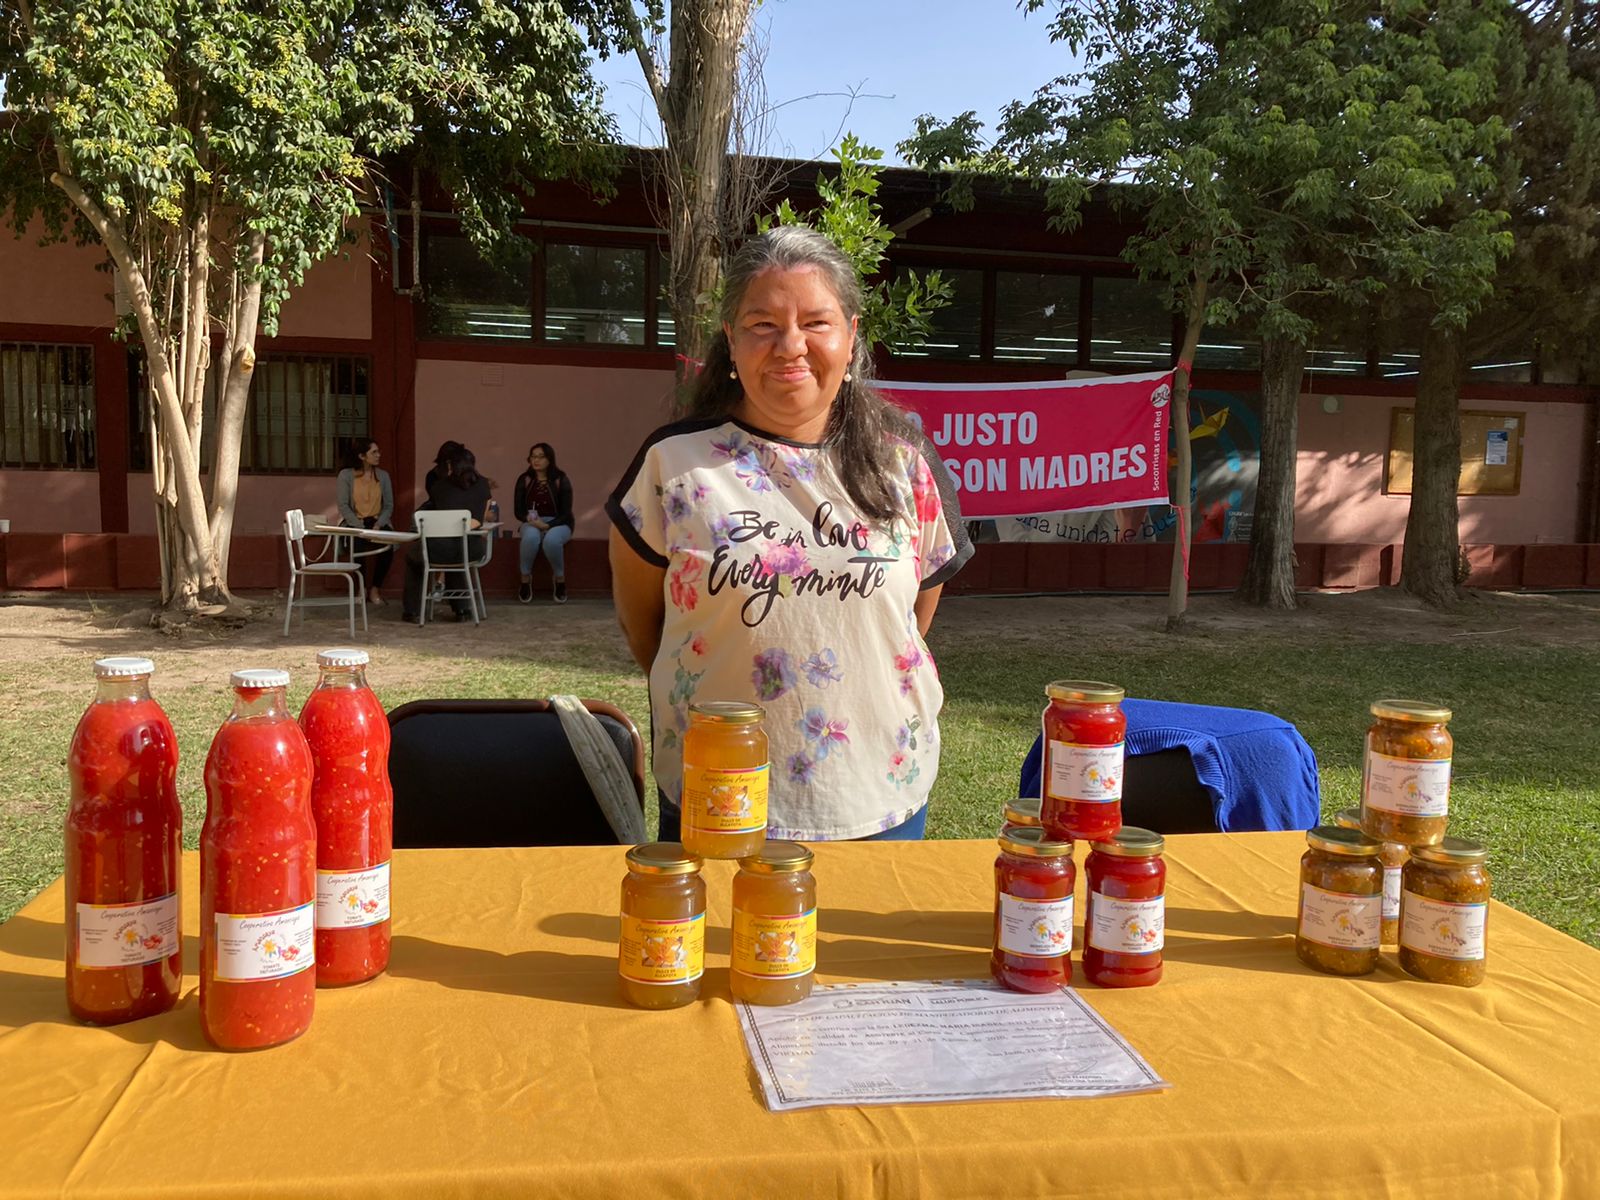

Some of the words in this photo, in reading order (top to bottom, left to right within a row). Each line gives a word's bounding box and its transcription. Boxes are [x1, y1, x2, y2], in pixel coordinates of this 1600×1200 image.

[933, 411, 1038, 447] JUSTO
[1153, 410, 1163, 428] Red
[1153, 430, 1161, 442] en
[942, 458, 1007, 492] SON
[1020, 444, 1147, 491] MADRES
[1152, 443, 1161, 492] Socorristas
[728, 510, 781, 543] Be
[778, 527, 808, 548] in
[812, 501, 868, 551] love
[708, 544, 785, 628] Every
[791, 556, 899, 602] minute
